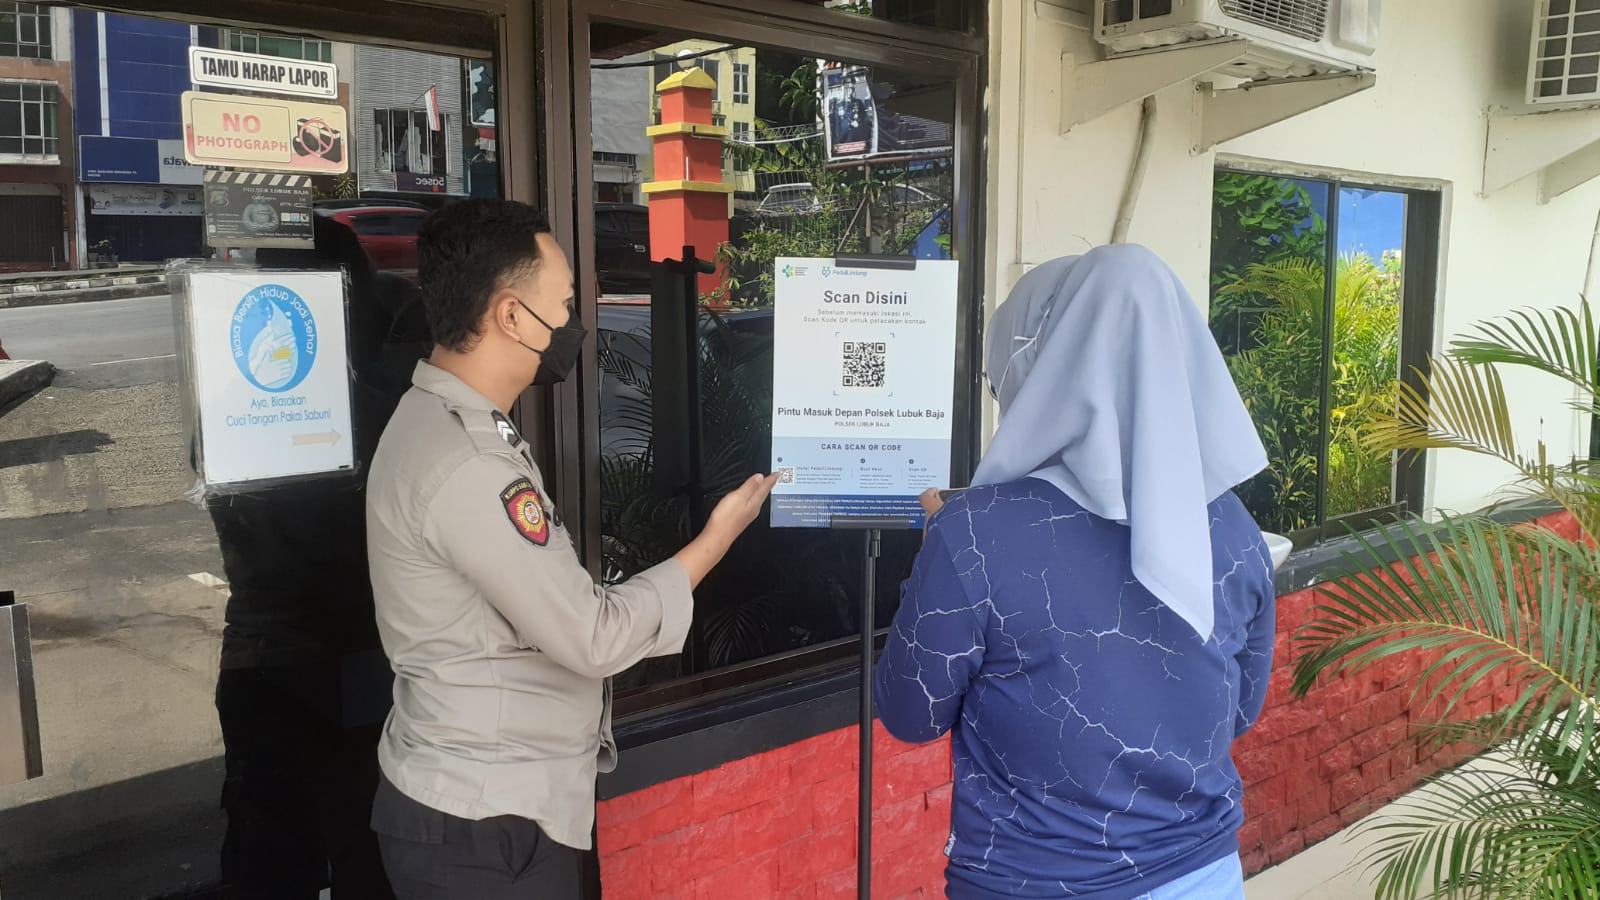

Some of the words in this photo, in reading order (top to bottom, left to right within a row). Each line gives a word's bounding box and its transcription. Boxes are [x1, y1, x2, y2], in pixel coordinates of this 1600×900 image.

[200, 56, 239, 78] TAMU
[242, 62, 286, 83] HARAP
[289, 67, 329, 88] LAPOR
[222, 112, 261, 134] NO
[196, 135, 288, 153] PHOTOGRAPH
[823, 290, 860, 304] Scan
[865, 291, 907, 305] Disini
[233, 325, 244, 358] Biasa
[260, 287, 289, 301] Hidup
[290, 296, 309, 319] Jadi
[304, 319, 315, 355] Sehat
[271, 395, 306, 407] Biasakan
[226, 414, 246, 427] Cuci
[247, 413, 279, 427] Tangan
[280, 410, 303, 422] Pakai
[777, 407, 801, 416] Pintu
[803, 407, 833, 417] Masuk
[834, 408, 863, 419] Depan
[865, 408, 894, 418] Polsek
[897, 409, 923, 418] Lubuk
[926, 409, 945, 420] Baja
